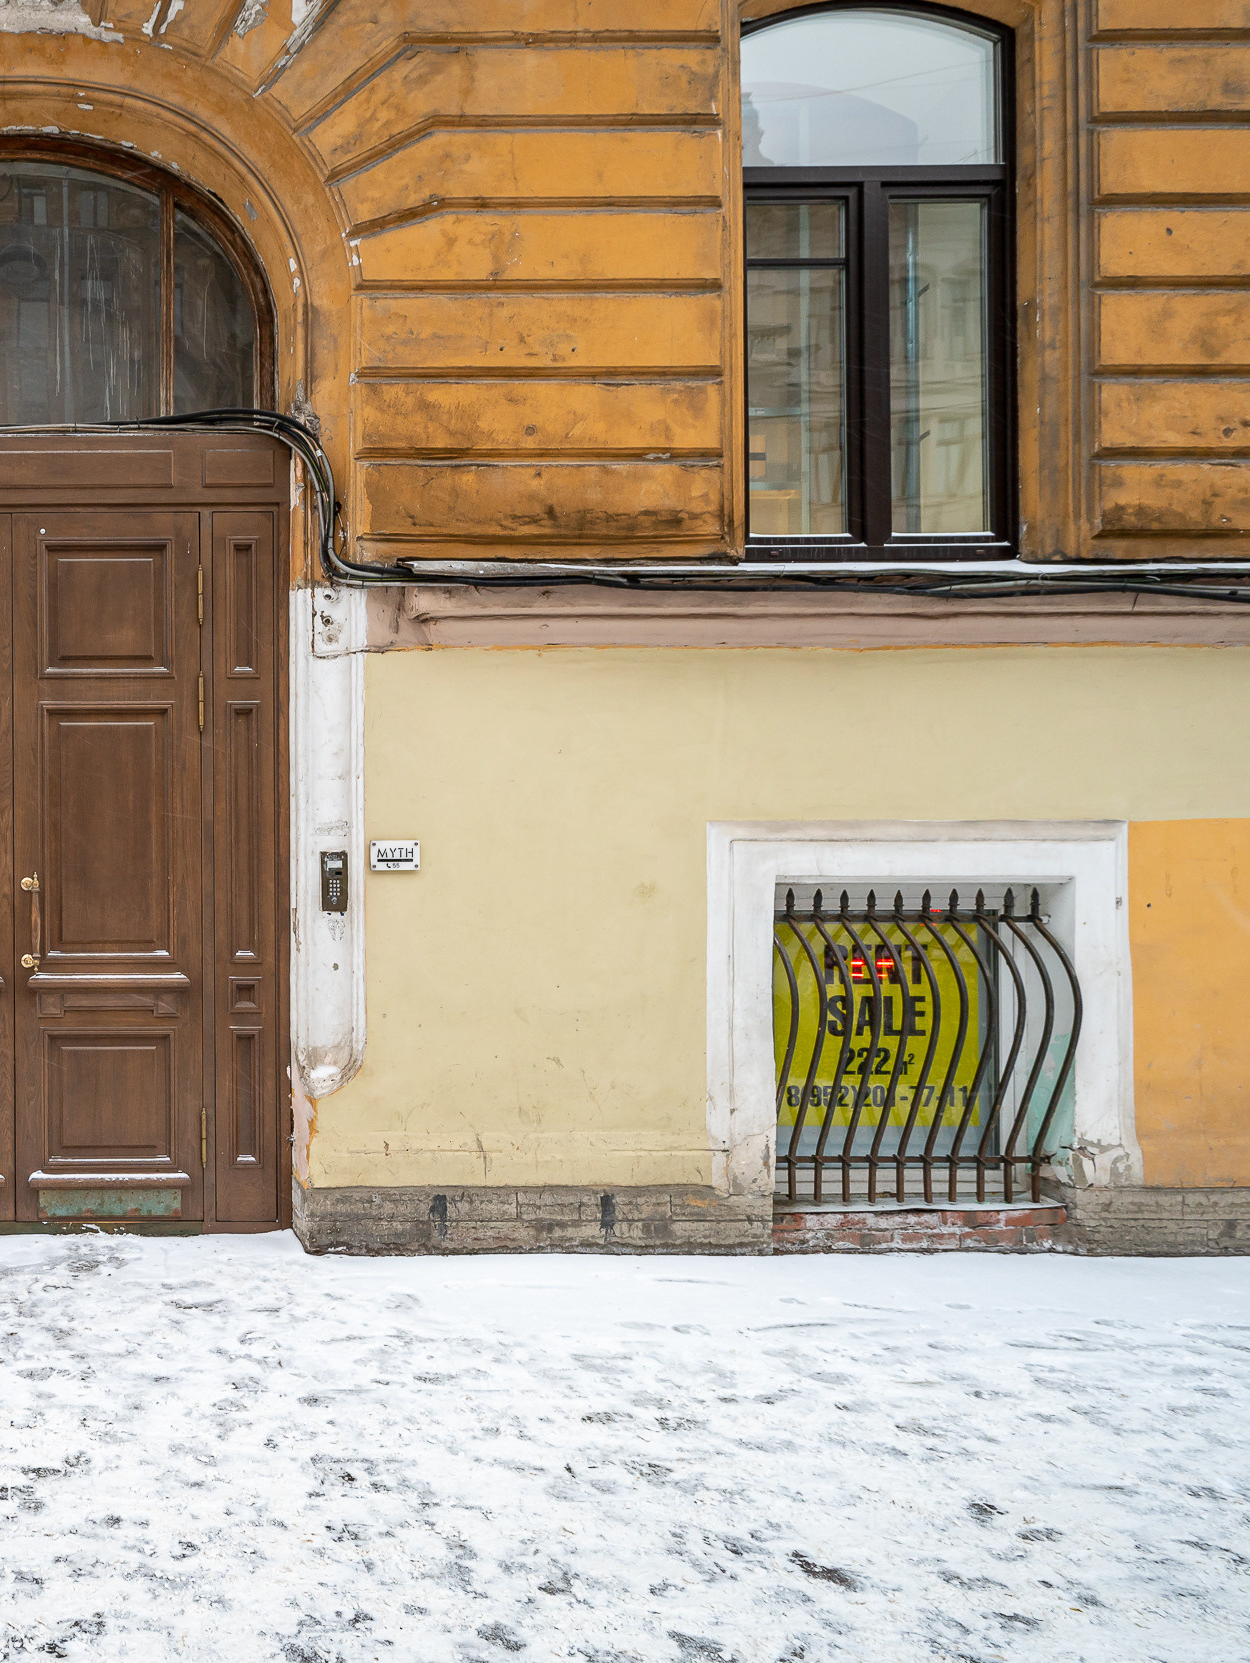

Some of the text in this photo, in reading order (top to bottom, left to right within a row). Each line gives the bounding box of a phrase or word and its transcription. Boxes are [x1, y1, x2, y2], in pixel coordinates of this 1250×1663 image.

[377, 848, 414, 858] MYTH
[823, 944, 928, 985] RENT
[826, 995, 926, 1037] SALE
[841, 1047, 891, 1076] 222
[786, 1085, 969, 1108] 8952)20-711
